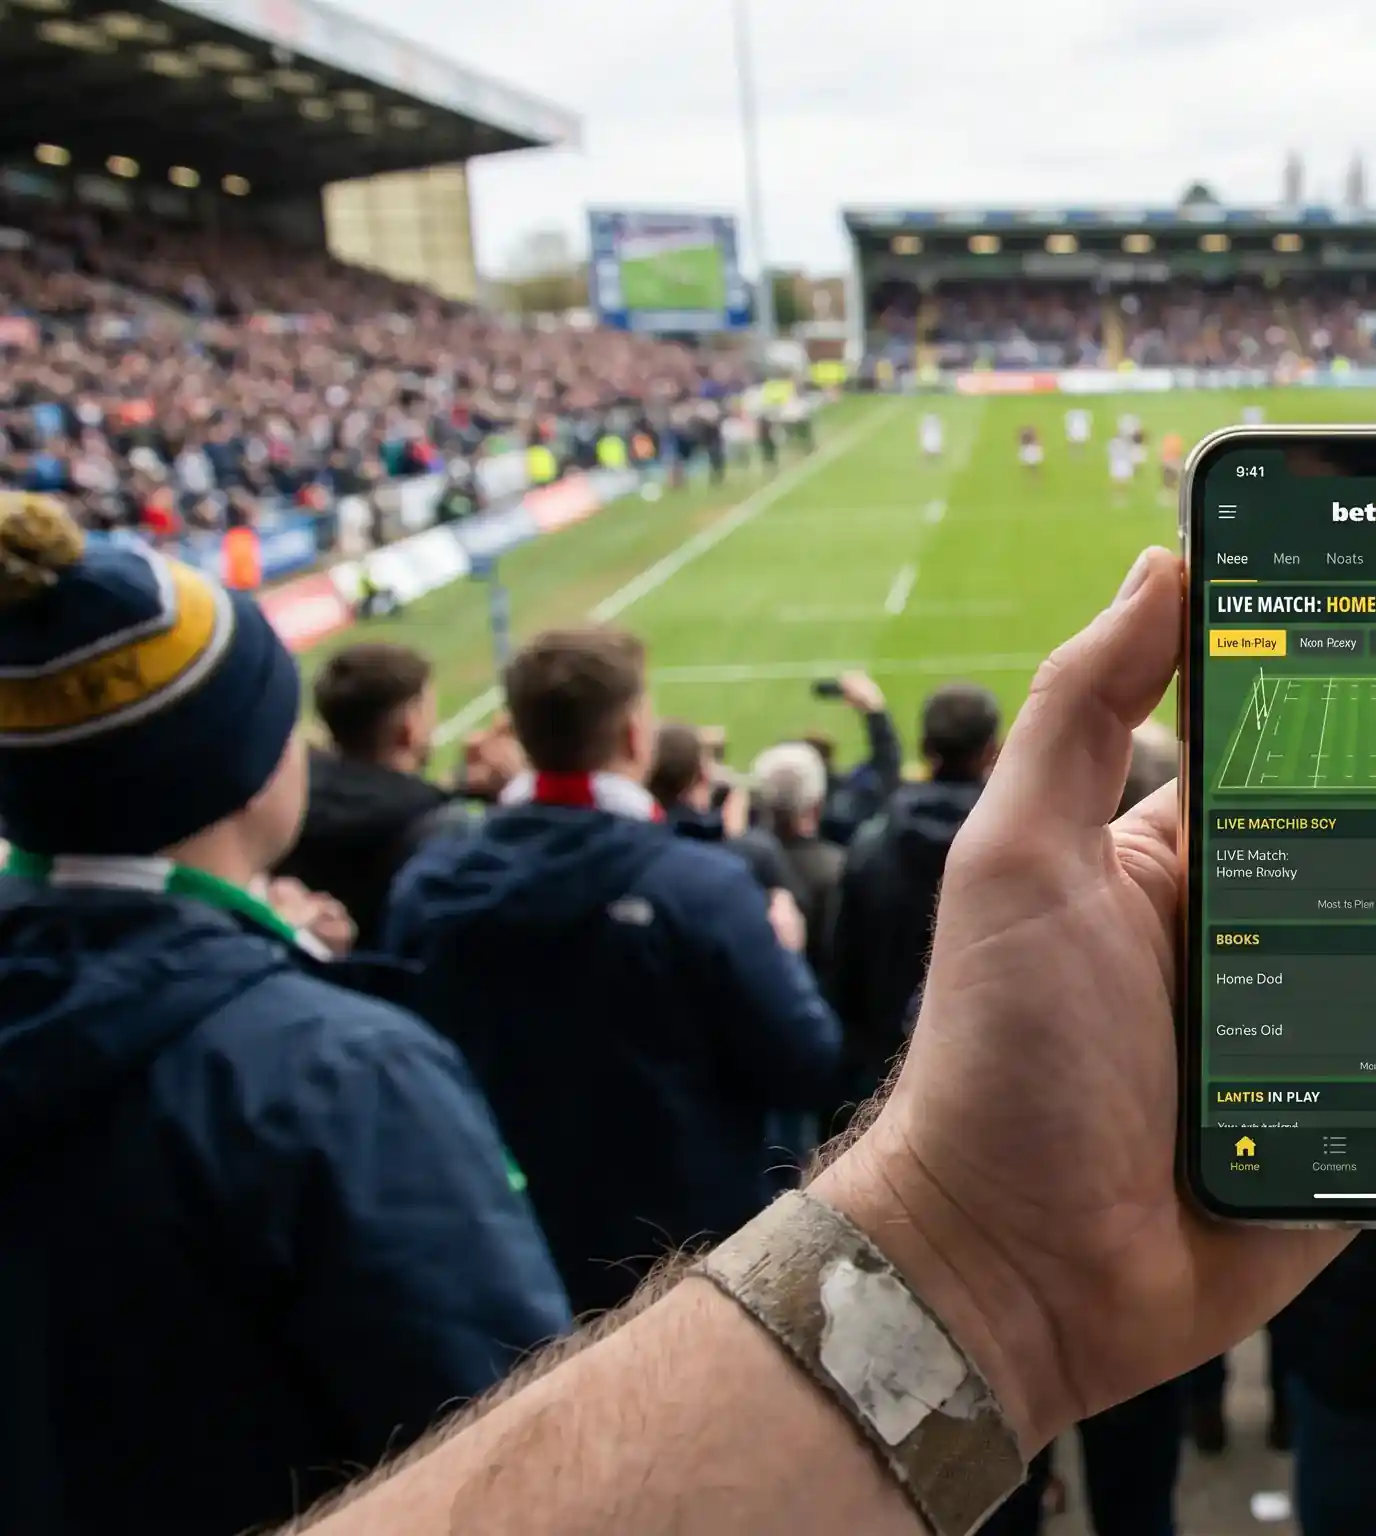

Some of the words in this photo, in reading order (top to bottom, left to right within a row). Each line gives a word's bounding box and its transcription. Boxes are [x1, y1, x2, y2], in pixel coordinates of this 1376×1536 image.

[1236, 466, 1265, 478] 9:41
[1217, 553, 1248, 565] Neee
[1274, 553, 1300, 565] Men
[1326, 553, 1364, 565] Noats
[1218, 596, 1253, 613] LIVE
[1258, 596, 1322, 613] MATCH:
[1327, 596, 1376, 613] HOME
[1217, 638, 1239, 648] Live
[1216, 818, 1245, 830] LIVE
[1248, 818, 1308, 830] MATCHIB
[1311, 818, 1337, 830] SCY
[1216, 850, 1244, 861] LIVE
[1248, 850, 1289, 861] Match:
[1216, 867, 1253, 878] Home
[1216, 973, 1253, 985] Home
[1257, 973, 1283, 985] Dod
[1217, 1092, 1264, 1103] LANTIS
[1268, 1092, 1282, 1103] IN
[1286, 1092, 1320, 1103] PLAY
[1230, 1162, 1260, 1171] Home
